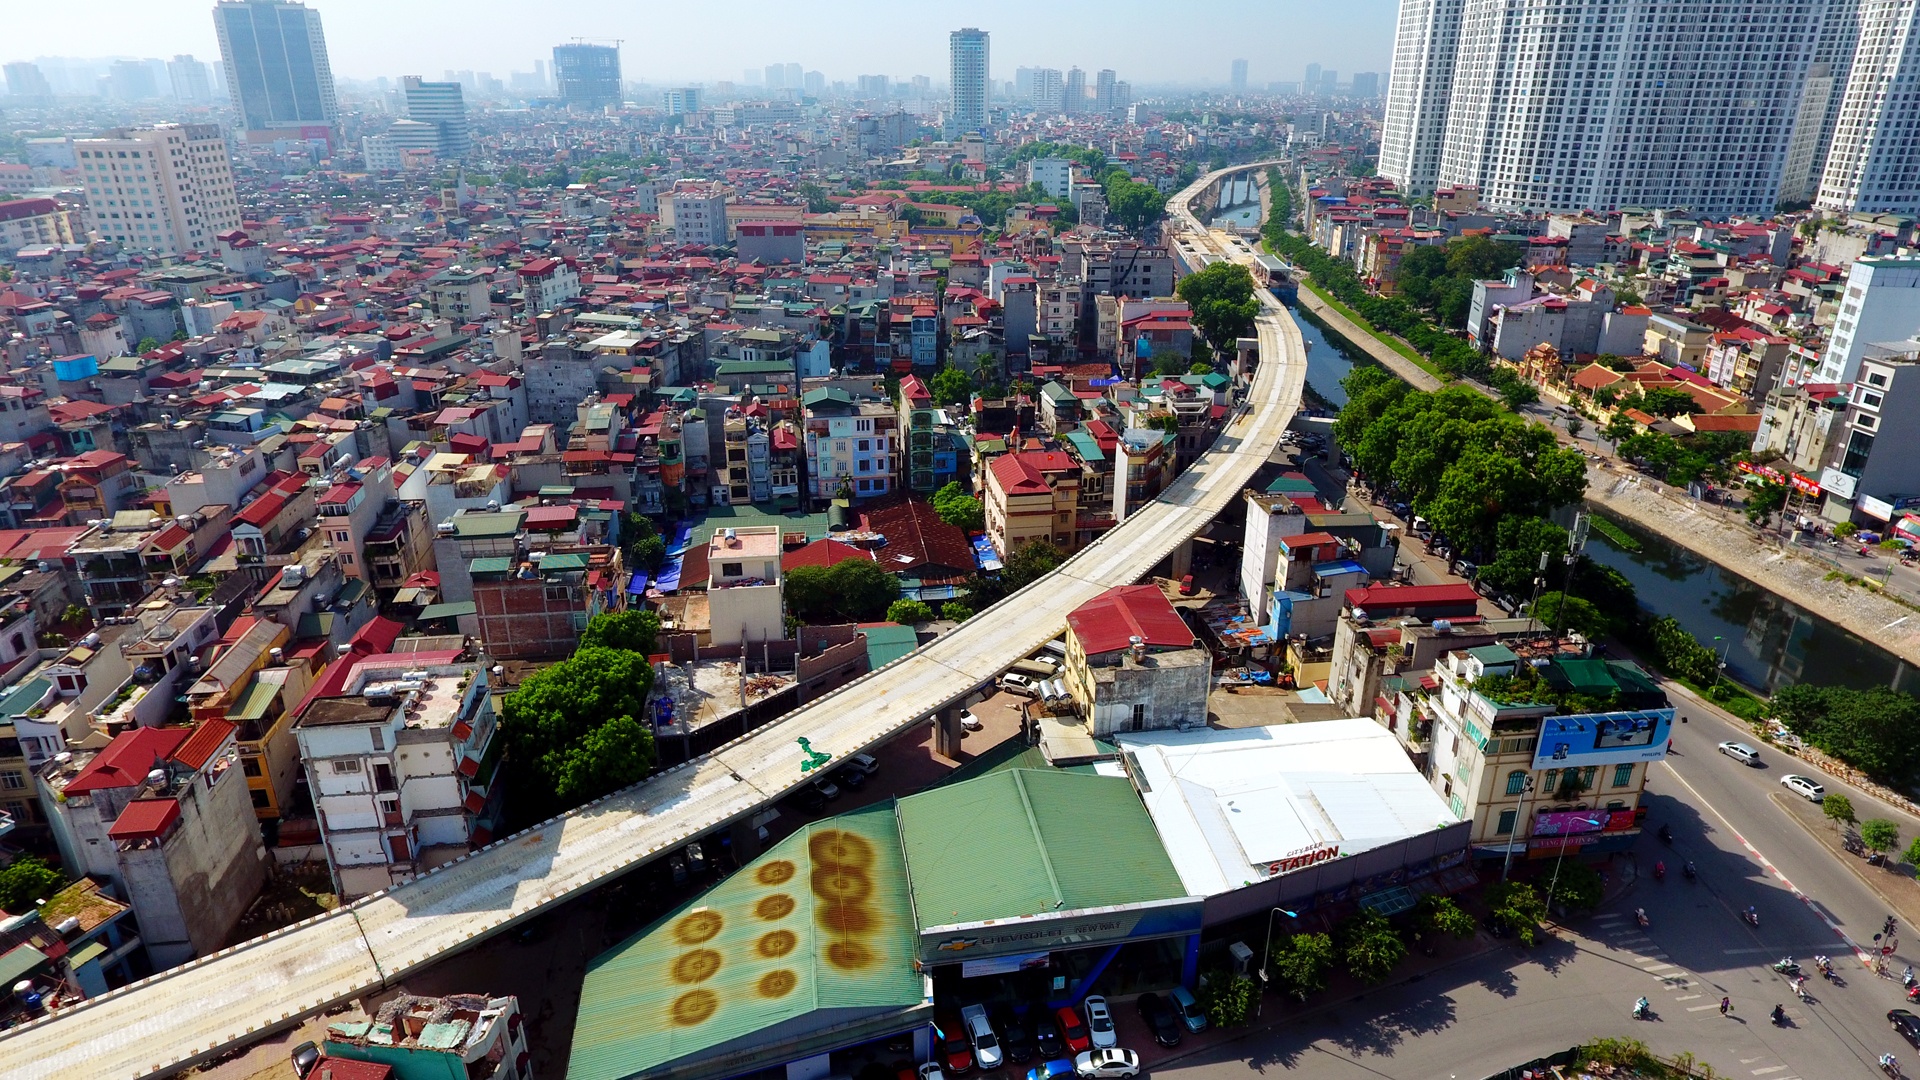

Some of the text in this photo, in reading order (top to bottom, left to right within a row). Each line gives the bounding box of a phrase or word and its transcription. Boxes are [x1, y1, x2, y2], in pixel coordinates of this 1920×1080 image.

[1269, 845, 1339, 876] STATION
[1287, 842, 1323, 857] CITY BEER
[982, 921, 1121, 945] CHEVROLET NEW WAY
